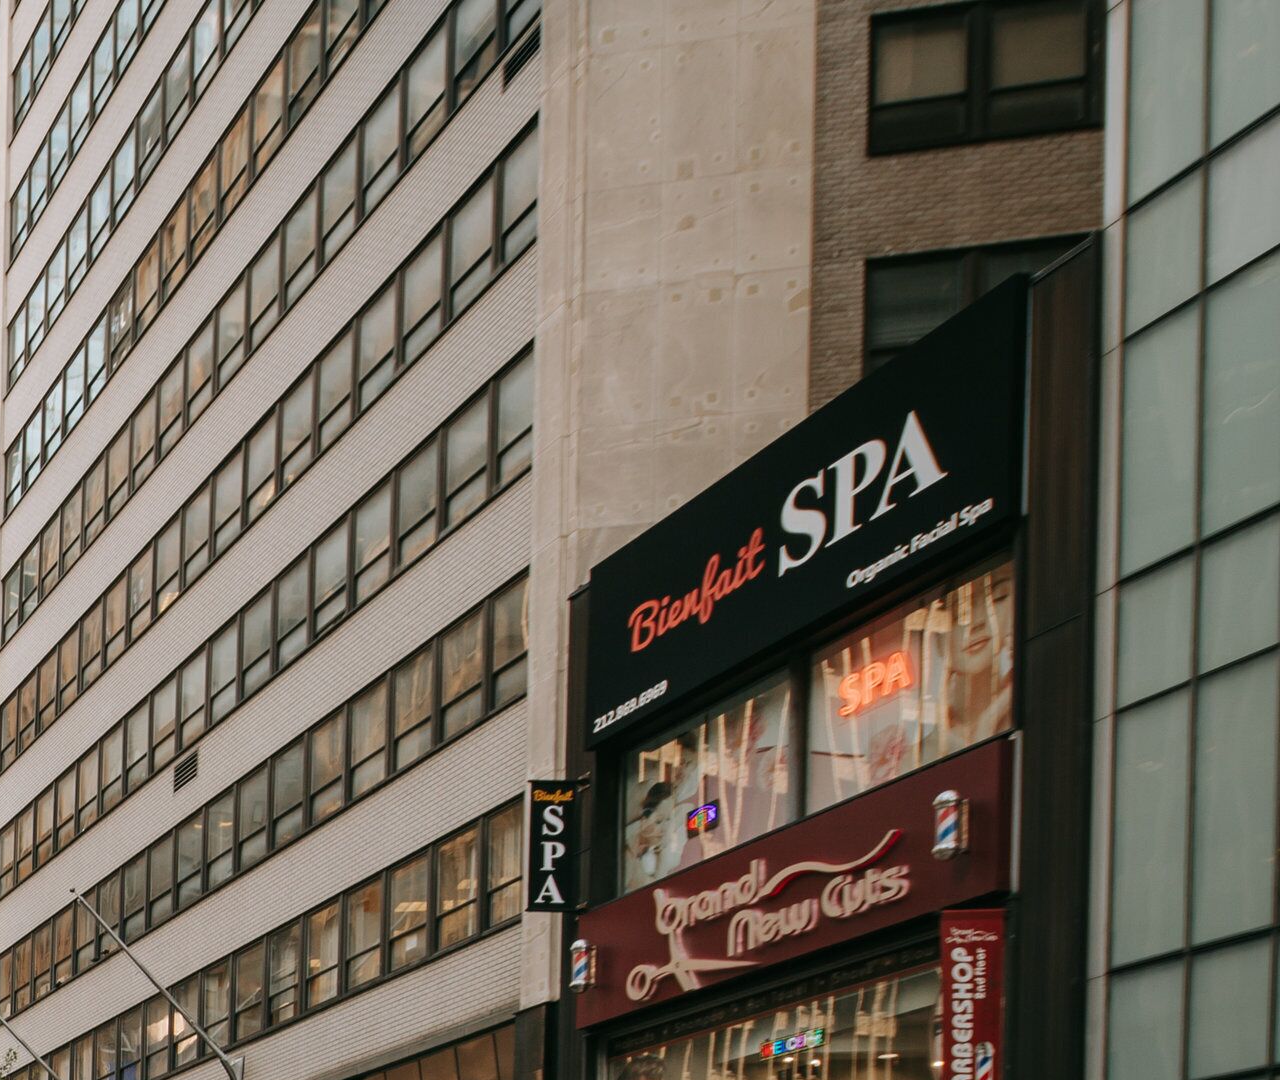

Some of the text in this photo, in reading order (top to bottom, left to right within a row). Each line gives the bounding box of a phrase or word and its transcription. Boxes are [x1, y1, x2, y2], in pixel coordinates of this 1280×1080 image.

[627, 409, 949, 652] Bienfait SPA
[846, 498, 994, 589] Organic Facial Spa
[838, 650, 915, 717] SPA
[534, 805, 566, 904] SPA
[727, 864, 910, 957] New Cuts
